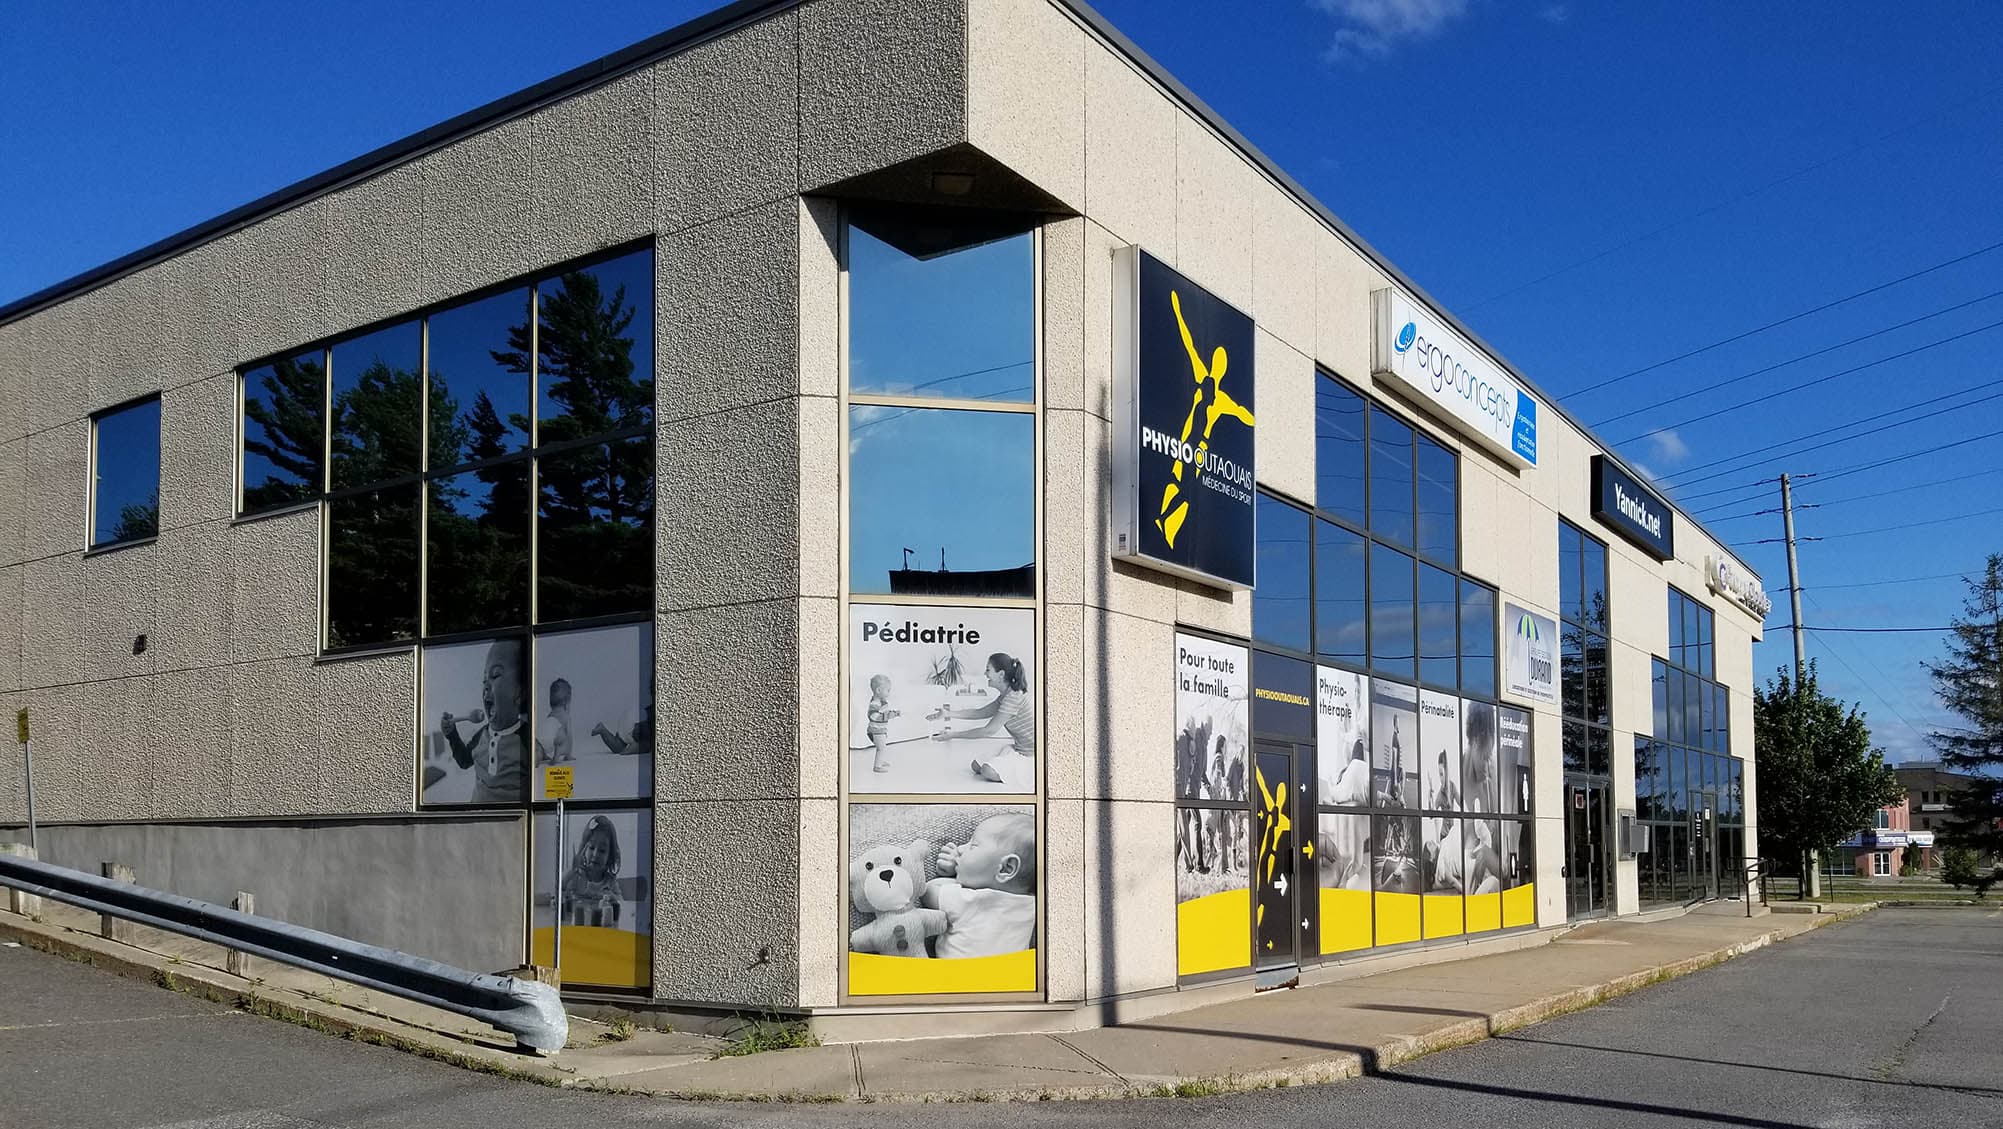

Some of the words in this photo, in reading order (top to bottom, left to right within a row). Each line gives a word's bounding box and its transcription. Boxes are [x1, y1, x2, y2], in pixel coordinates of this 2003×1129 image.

[1417, 336, 1510, 433] ergoconcepts
[1202, 475, 1230, 496] MÉDECINE
[1231, 487, 1238, 499] DU
[1239, 491, 1252, 506] SPORT
[1614, 482, 1661, 539] Yannick.net
[863, 621, 980, 645] Pédiatrie
[1180, 647, 1205, 669] Pour
[1208, 655, 1234, 674] toute
[1179, 672, 1190, 692] la
[1193, 674, 1229, 698] famille
[1255, 687, 1310, 707] PHYSIOOUTAOUAIS.CA
[1319, 678, 1347, 699] Physio-
[1319, 699, 1352, 721] thérapie
[1420, 700, 1455, 719] Périnatalité
